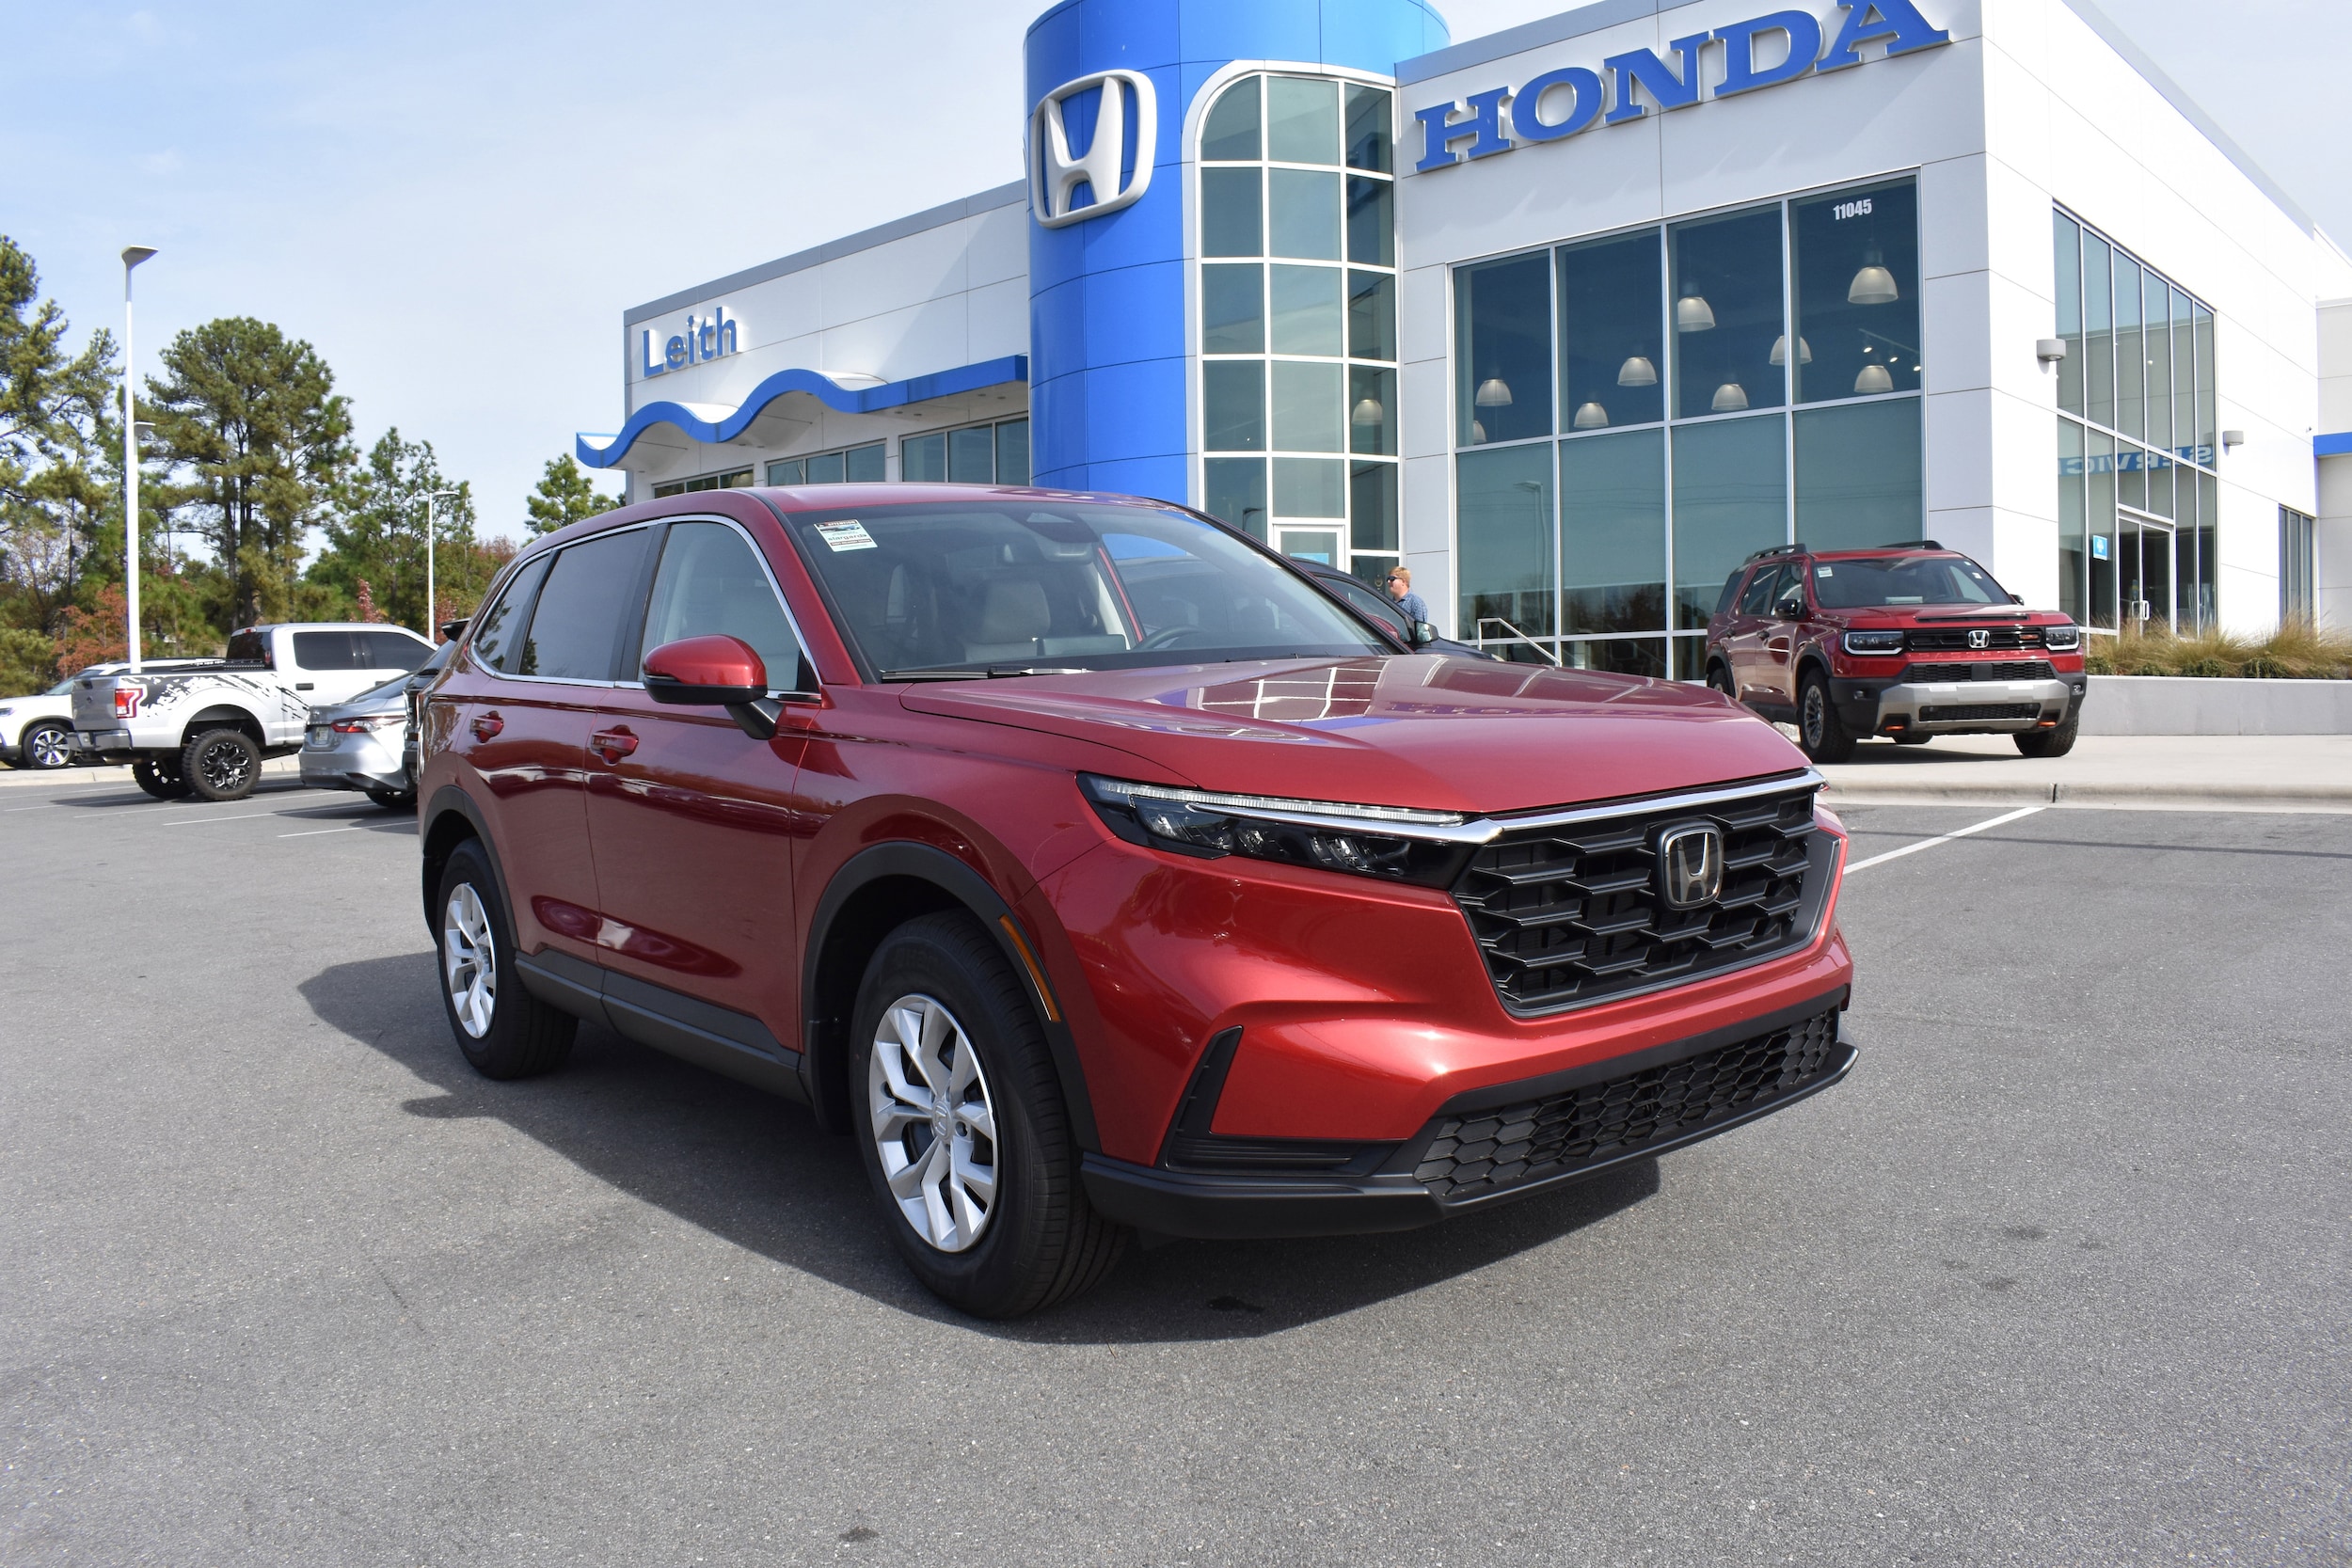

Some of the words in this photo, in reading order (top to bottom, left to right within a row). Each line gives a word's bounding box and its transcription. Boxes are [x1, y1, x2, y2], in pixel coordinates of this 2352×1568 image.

[1414, 0, 1949, 171] HONDA
[1833, 198, 1872, 220] 11045
[643, 306, 738, 377] Leith
